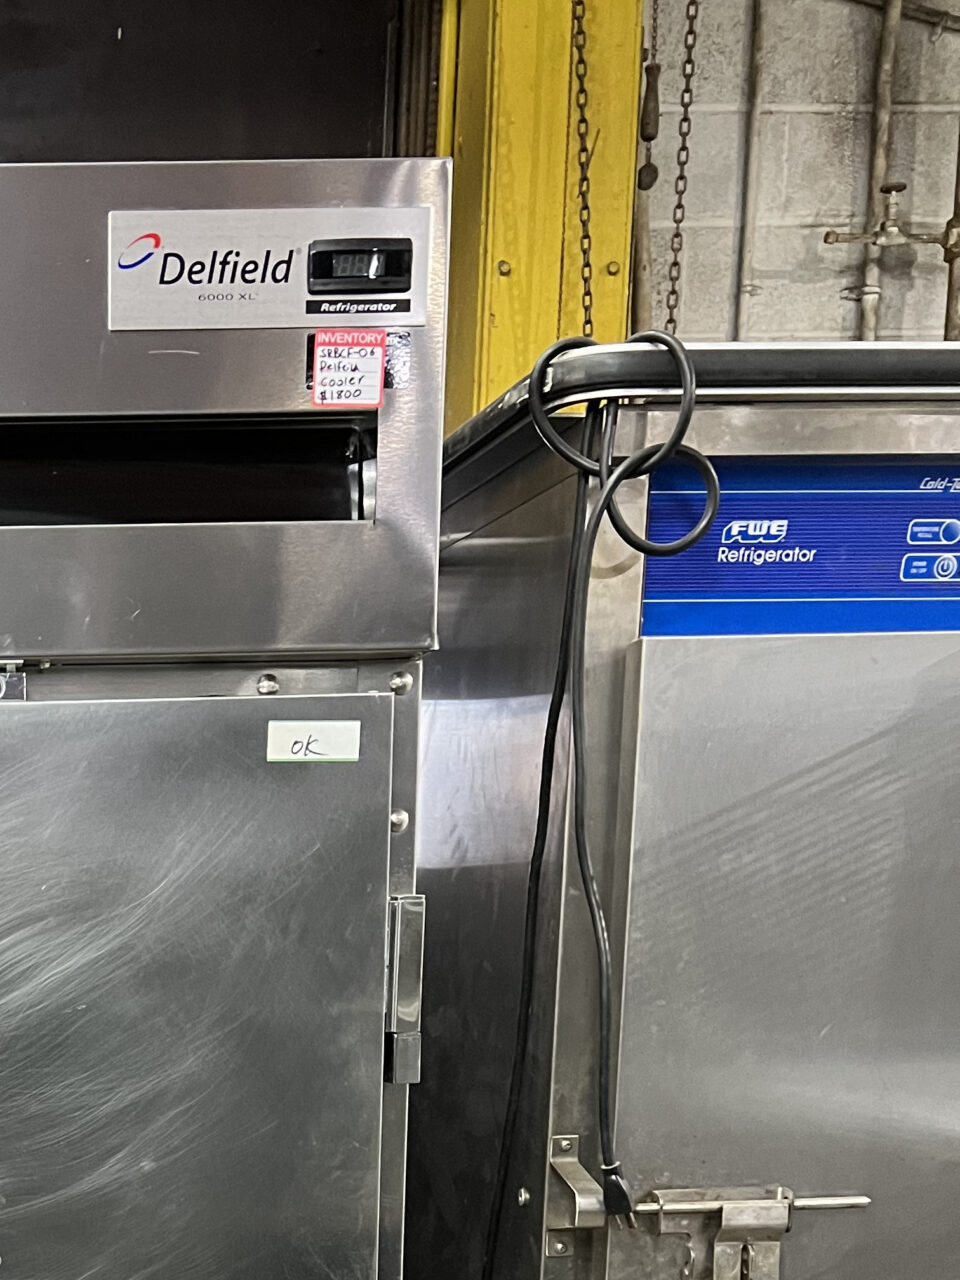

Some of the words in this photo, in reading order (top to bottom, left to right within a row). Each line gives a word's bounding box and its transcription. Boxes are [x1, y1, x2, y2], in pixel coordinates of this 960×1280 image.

[159, 249, 294, 285] Delfield
[198, 293, 234, 301] 6000
[238, 292, 256, 301] XL
[320, 302, 397, 313] Refrigerator
[318, 332, 384, 344] INVENTORY
[319, 389, 362, 404] $1800
[920, 477, 960, 492] Cold-T
[728, 520, 788, 537] FWE
[717, 547, 817, 565] Refrigerator
